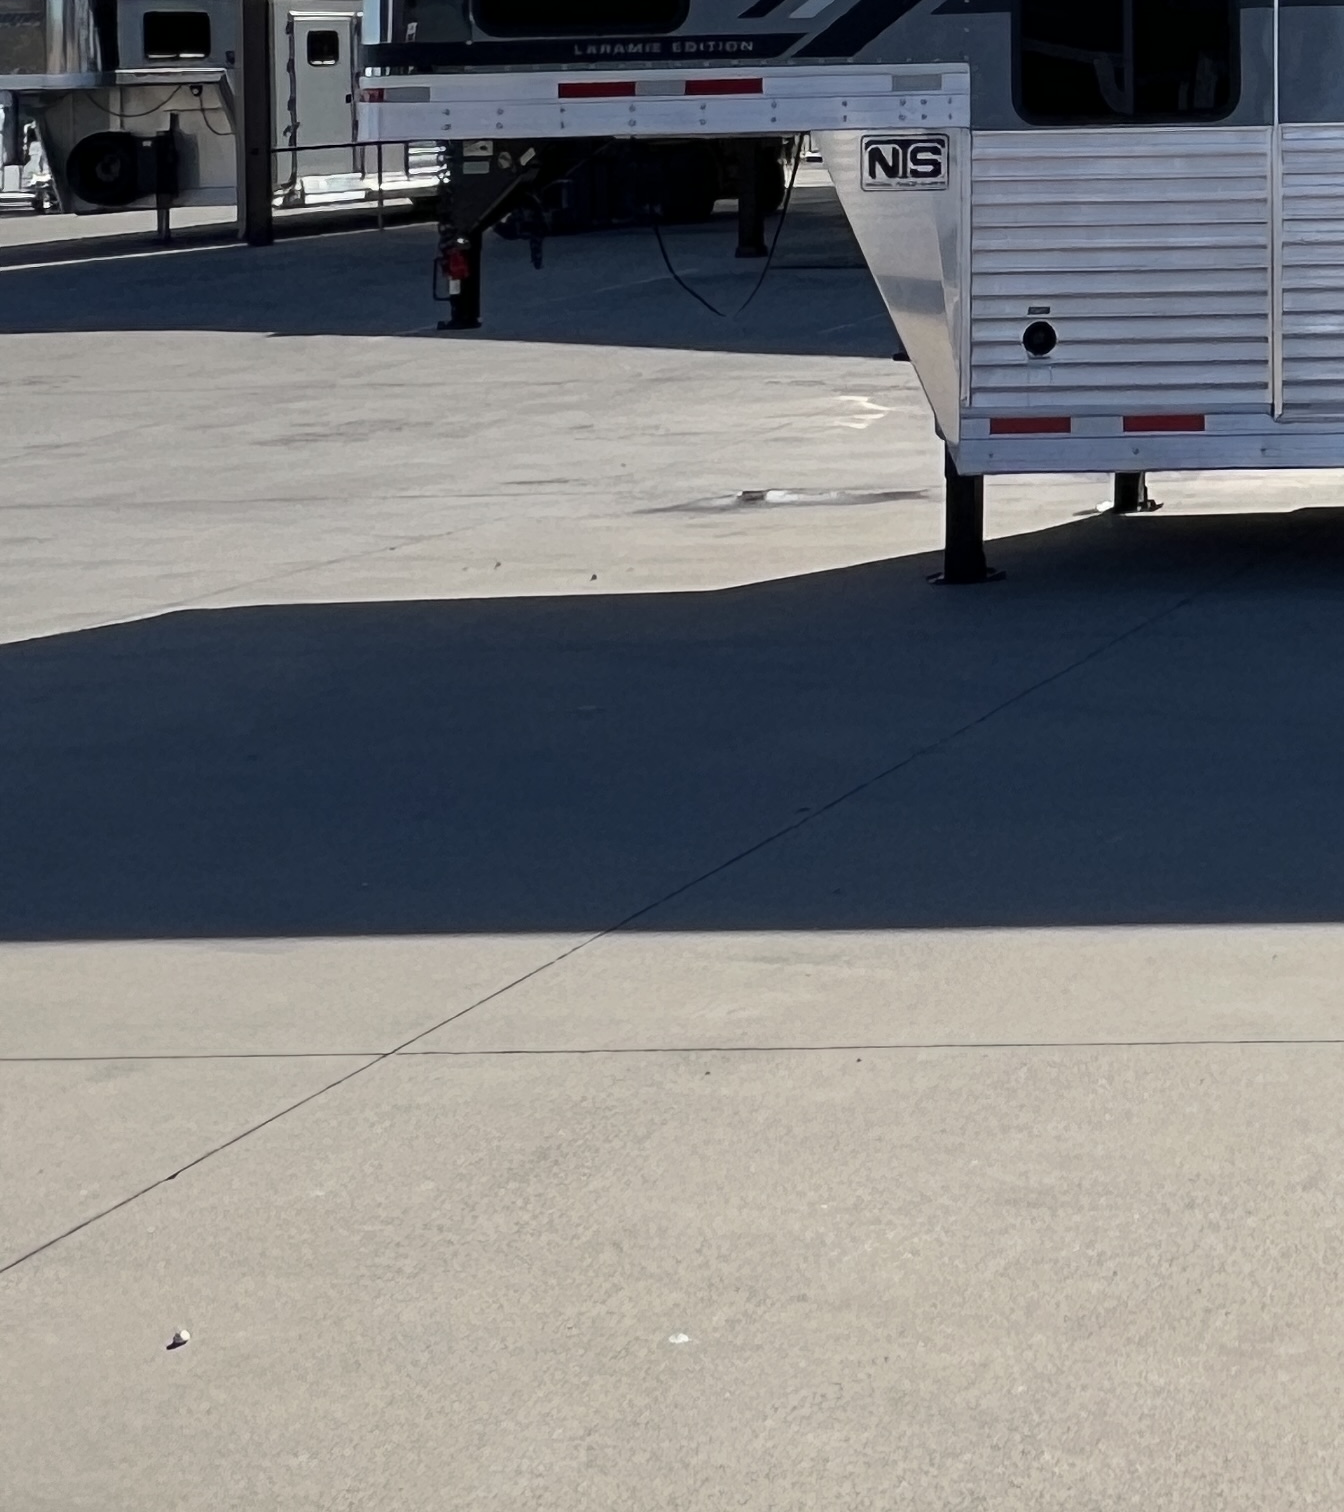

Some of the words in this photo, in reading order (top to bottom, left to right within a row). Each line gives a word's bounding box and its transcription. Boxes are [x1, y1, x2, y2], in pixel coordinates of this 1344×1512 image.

[574, 41, 662, 56] LARAMIE
[671, 40, 754, 54] EDITION
[865, 138, 946, 180] NTS
